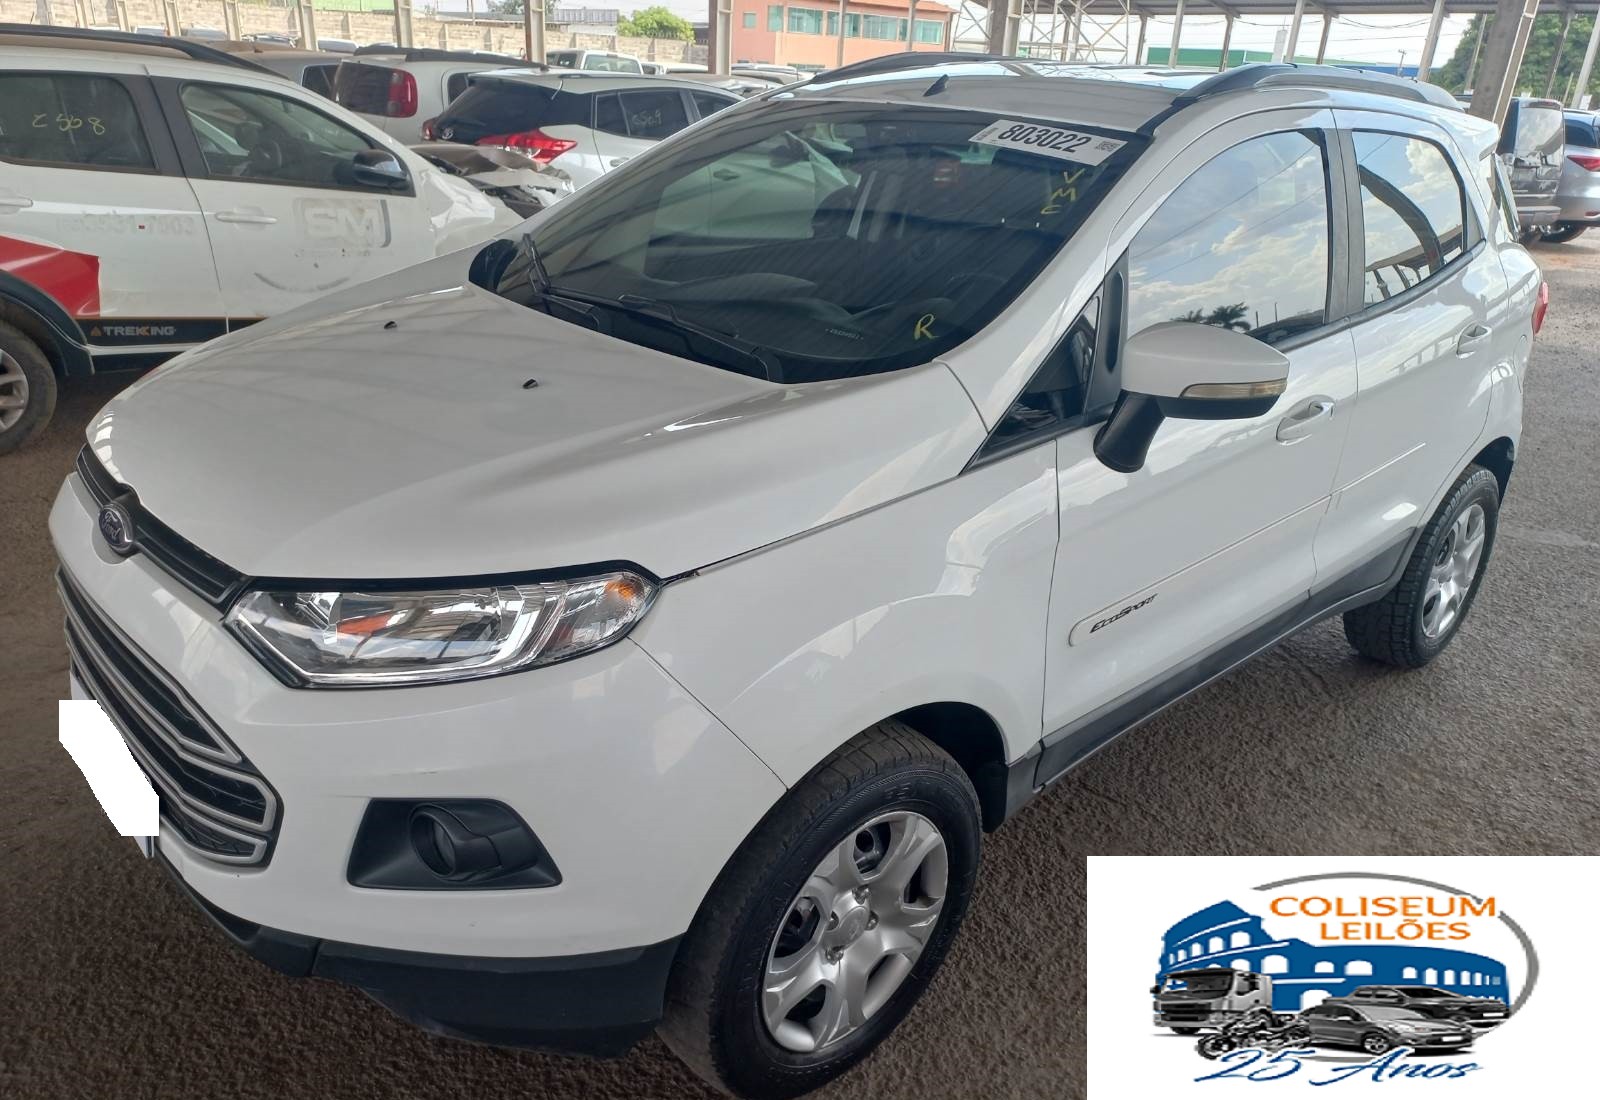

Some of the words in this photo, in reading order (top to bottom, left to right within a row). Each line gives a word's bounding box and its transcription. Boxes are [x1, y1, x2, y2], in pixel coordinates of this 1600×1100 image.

[997, 124, 1092, 153] 803022
[103, 325, 176, 337] TREKKING
[913, 313, 940, 340] R
